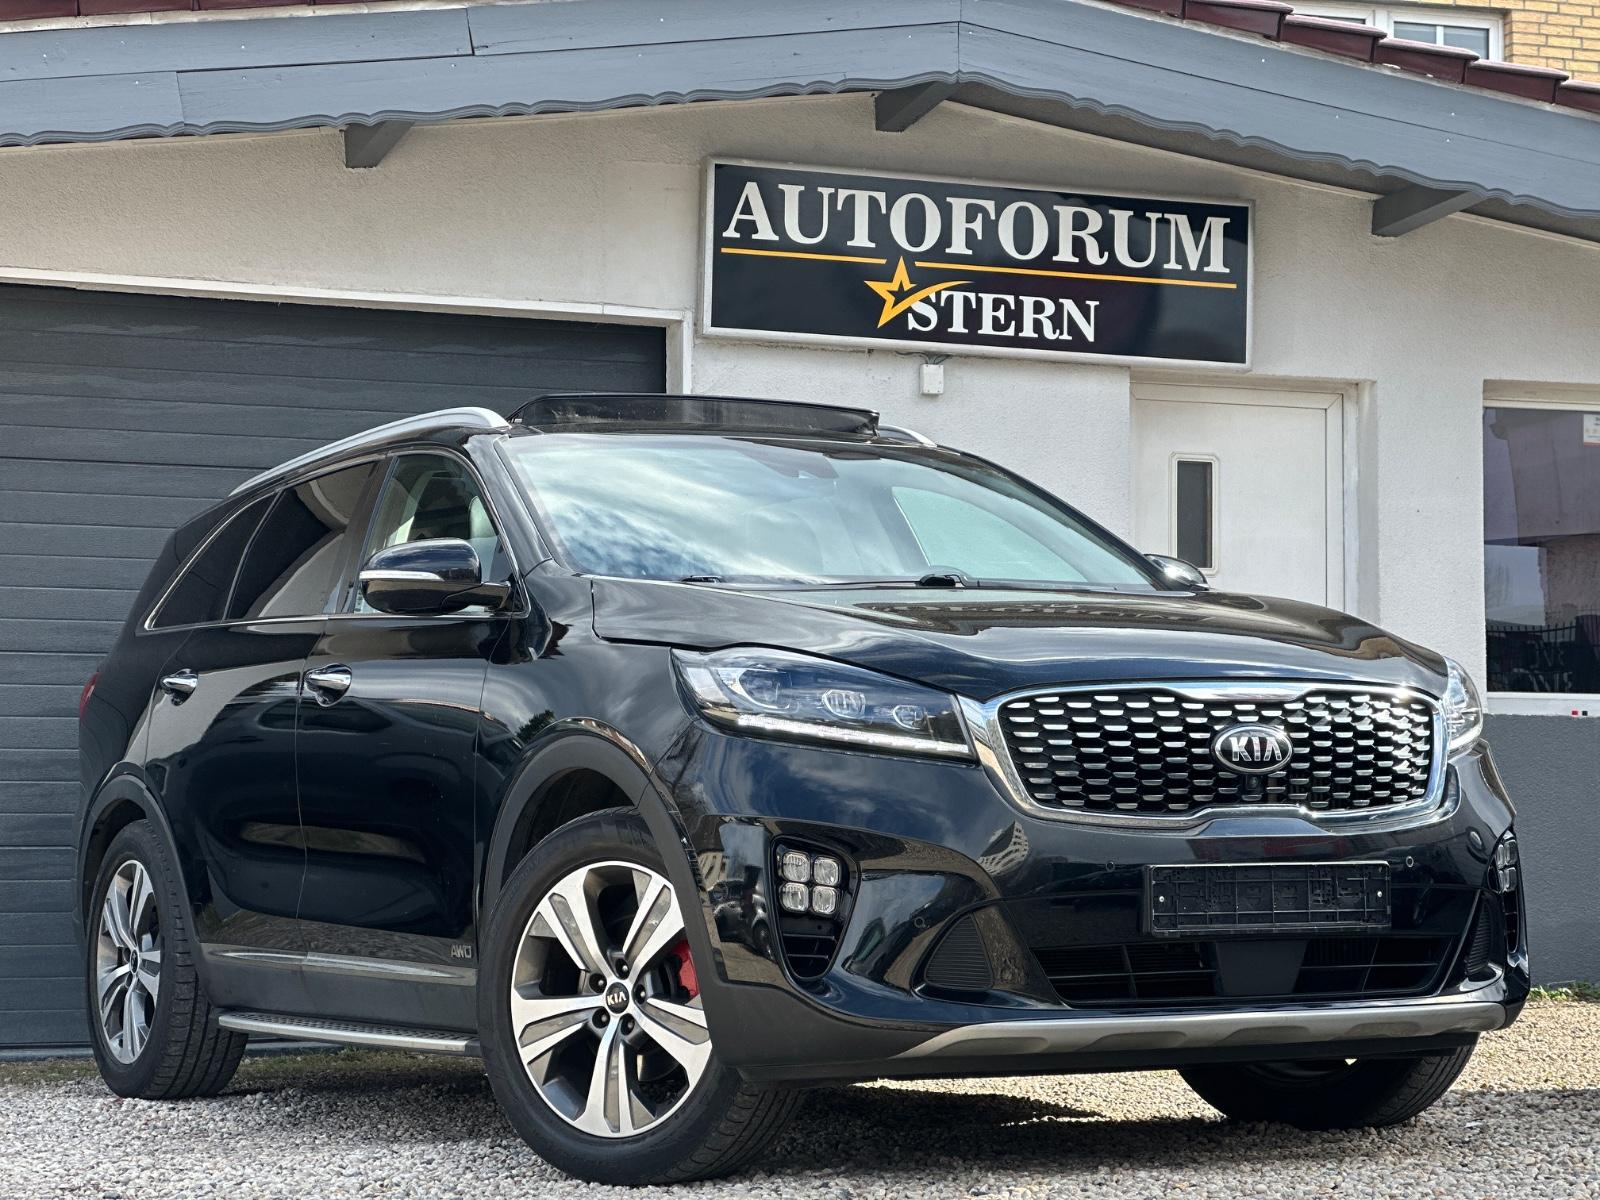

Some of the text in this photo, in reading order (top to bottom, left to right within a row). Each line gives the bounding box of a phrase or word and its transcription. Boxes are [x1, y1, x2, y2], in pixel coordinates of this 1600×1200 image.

[722, 181, 1231, 274] AUTOFORUM
[907, 290, 1100, 343] STERN
[1229, 736, 1283, 762] KIA
[606, 991, 627, 1006] KIA
